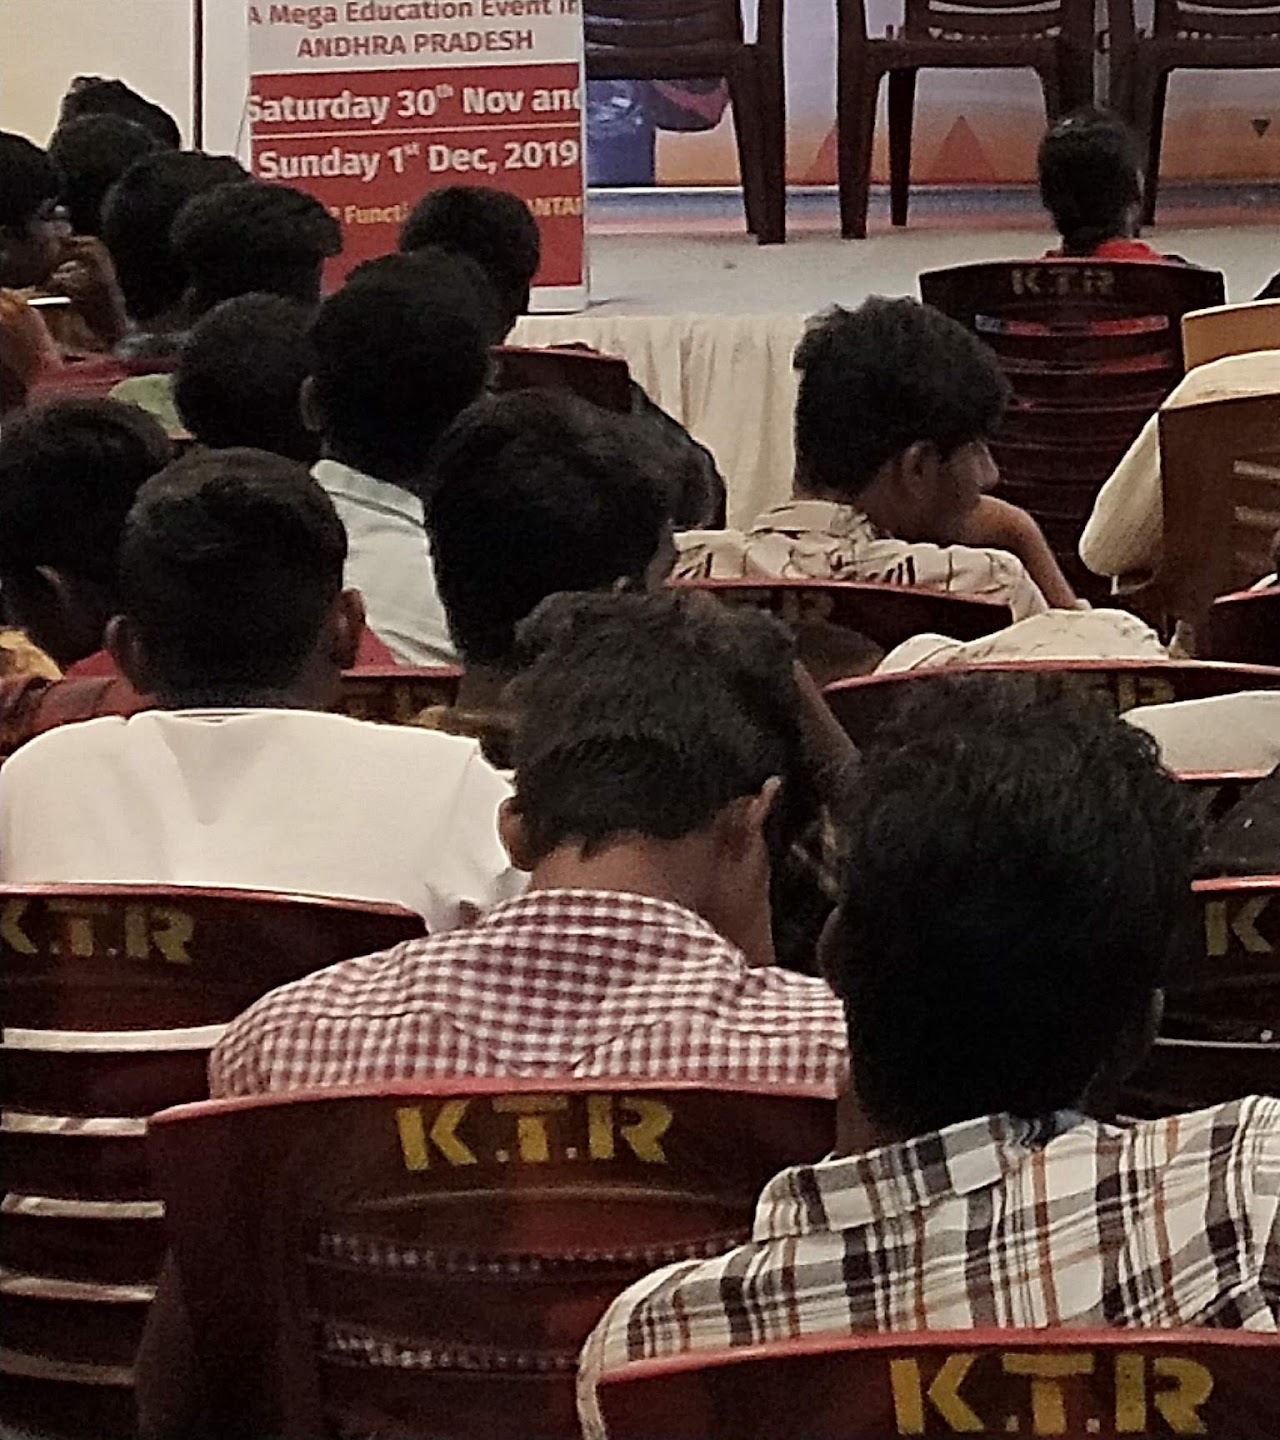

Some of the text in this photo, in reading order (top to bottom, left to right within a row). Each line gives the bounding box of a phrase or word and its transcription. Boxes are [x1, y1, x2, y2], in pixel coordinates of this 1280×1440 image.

[269, 3, 338, 30] Mega
[297, 29, 534, 59] ANDHRA PRADESH
[247, 89, 390, 126] Saturday
[396, 82, 454, 117] 30th
[462, 86, 525, 115] Nov
[258, 139, 579, 183] Sunday 1st Dec, 2019
[395, 1092, 676, 1171] K.T.R
[890, 1352, 1216, 1437] K.T.R
